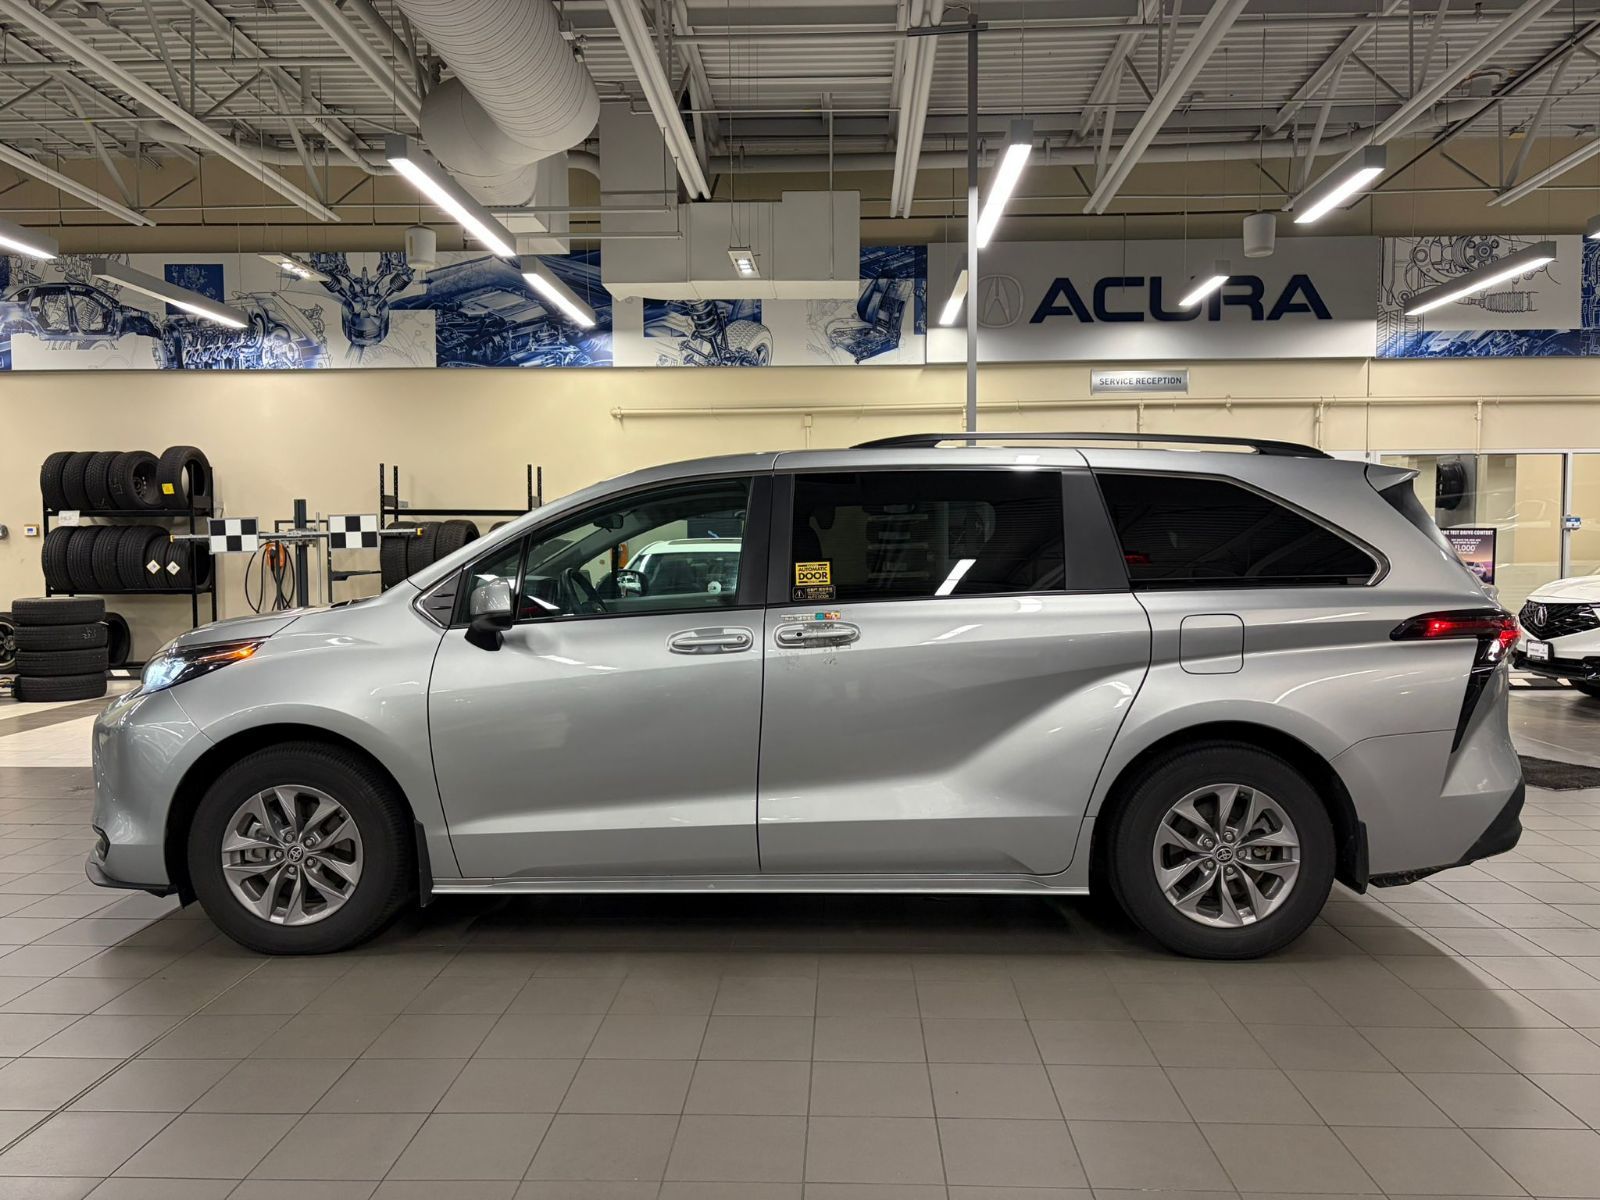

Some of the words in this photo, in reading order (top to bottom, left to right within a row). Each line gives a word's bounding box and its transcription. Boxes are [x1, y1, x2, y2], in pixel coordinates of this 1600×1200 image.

[1029, 274, 1333, 324] ACURA
[1099, 378, 1133, 386] SERVICE
[1136, 376, 1182, 385] RECEPTION
[798, 572, 828, 580] DOOR
